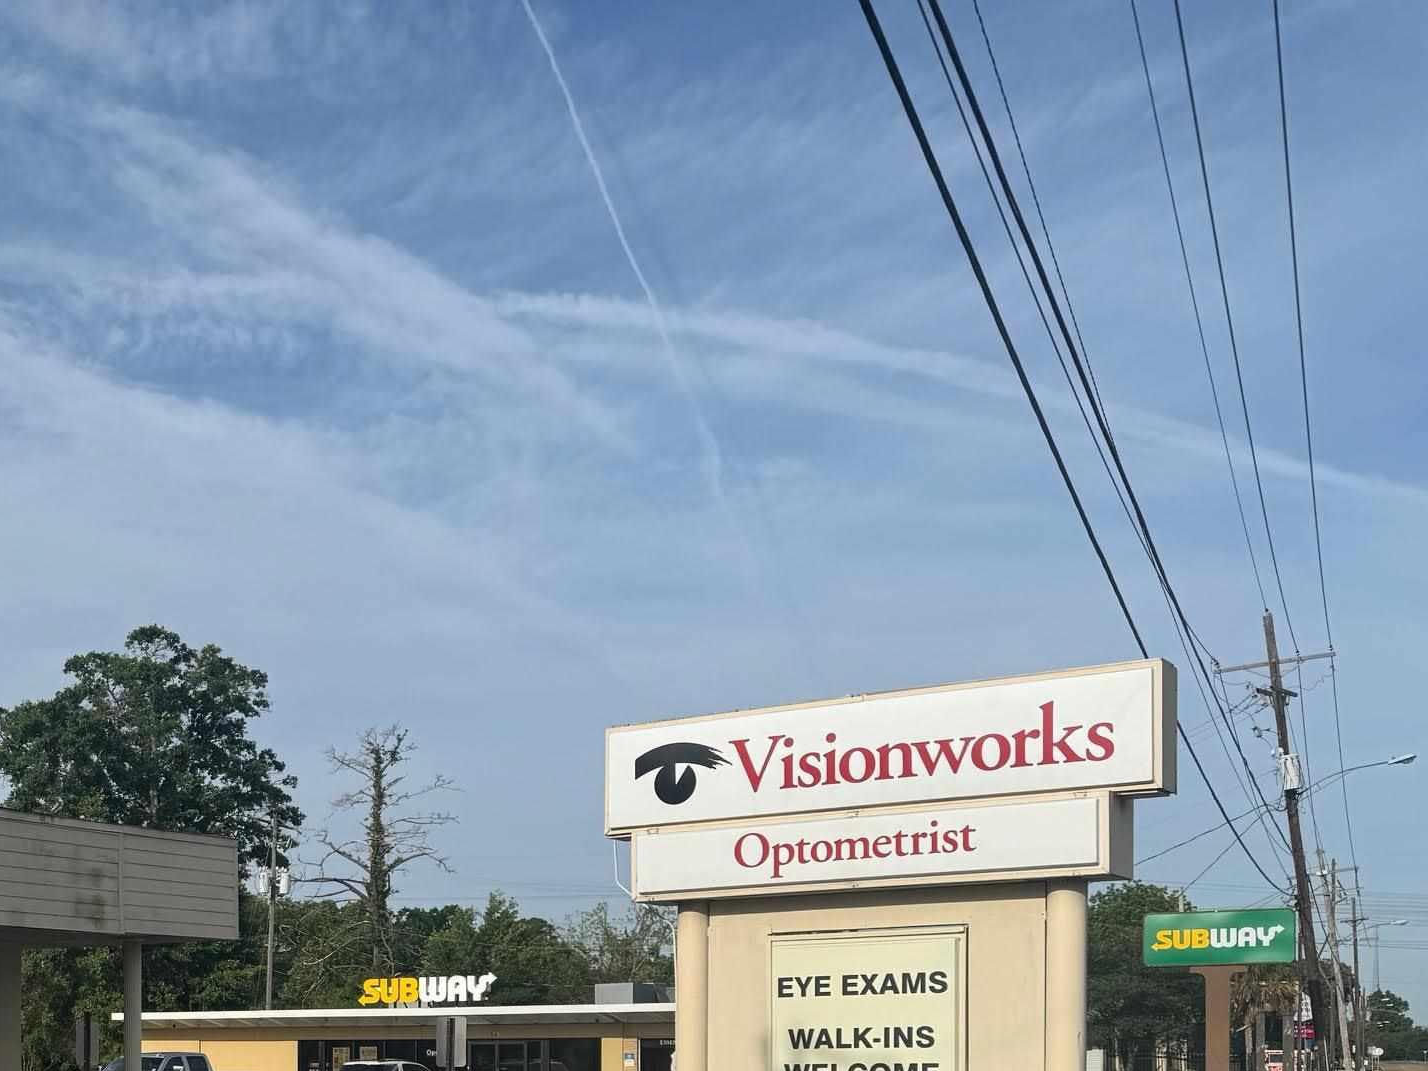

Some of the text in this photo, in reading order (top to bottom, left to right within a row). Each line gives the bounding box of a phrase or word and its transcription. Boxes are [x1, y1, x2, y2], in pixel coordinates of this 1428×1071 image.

[730, 701, 1115, 793] Visionworks
[734, 818, 978, 878] Optometrist
[1151, 923, 1285, 952] SUBWAY
[356, 971, 499, 1006] SUBWAY
[777, 971, 949, 999] EYE EXAMS
[788, 1026, 936, 1050] WALK-INS
